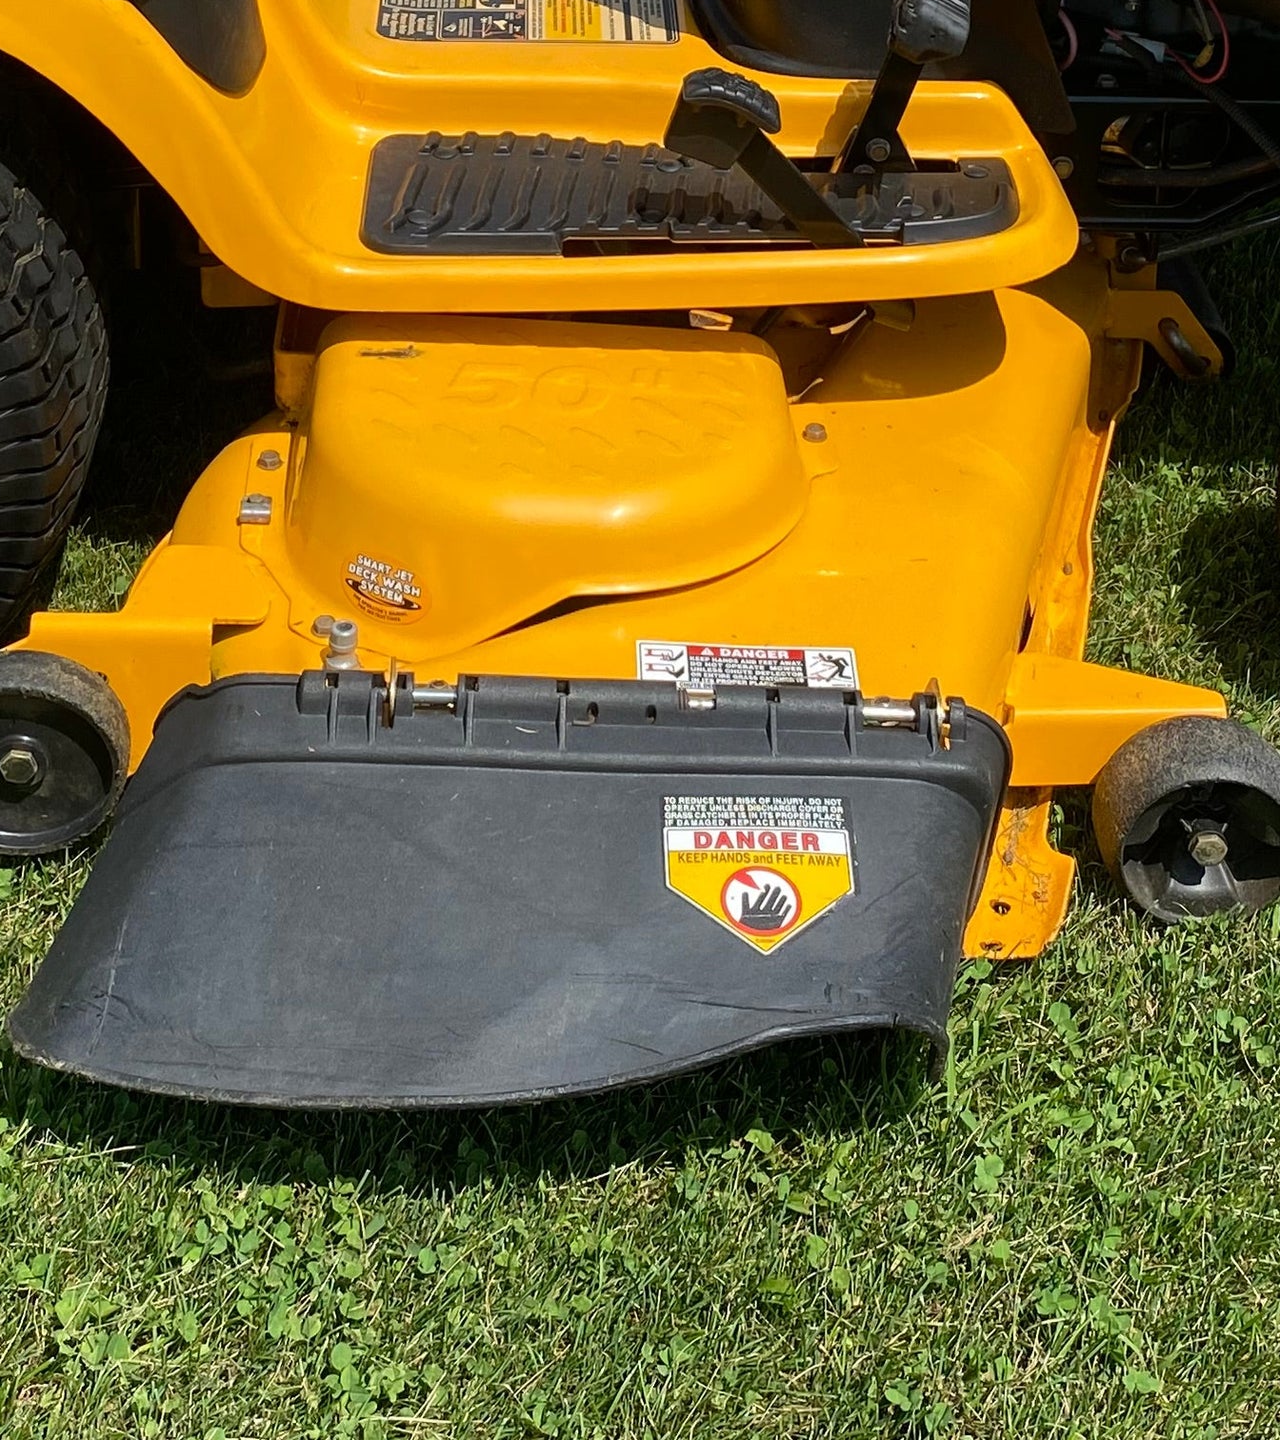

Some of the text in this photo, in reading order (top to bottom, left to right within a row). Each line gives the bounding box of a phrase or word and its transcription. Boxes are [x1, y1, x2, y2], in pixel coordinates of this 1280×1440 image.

[357, 554, 413, 582] SMART JET
[348, 563, 421, 597] DECK WASH
[359, 580, 403, 603] SYSTEM
[720, 647, 789, 659] DANGER
[664, 796, 677, 805] TO
[678, 796, 715, 805] REDUCE
[716, 796, 734, 805] THE
[735, 796, 757, 805] RISK
[759, 796, 771, 805] OF
[808, 797, 822, 806] DO
[824, 797, 842, 806] NOT
[663, 804, 844, 814] OPERATE UNLESS DISCHARGE COVER OR
[664, 811, 694, 819] GRASS
[694, 811, 736, 819] CATCHER
[737, 811, 747, 819] IS
[748, 811, 758, 819] IN
[759, 812, 774, 820] ITS
[775, 812, 811, 820] PROPER
[664, 819, 674, 827] IF
[730, 819, 775, 827] REPLACE
[693, 831, 821, 852] DANGER
[677, 852, 841, 867] KEEP HANDS and FEET AWAY
